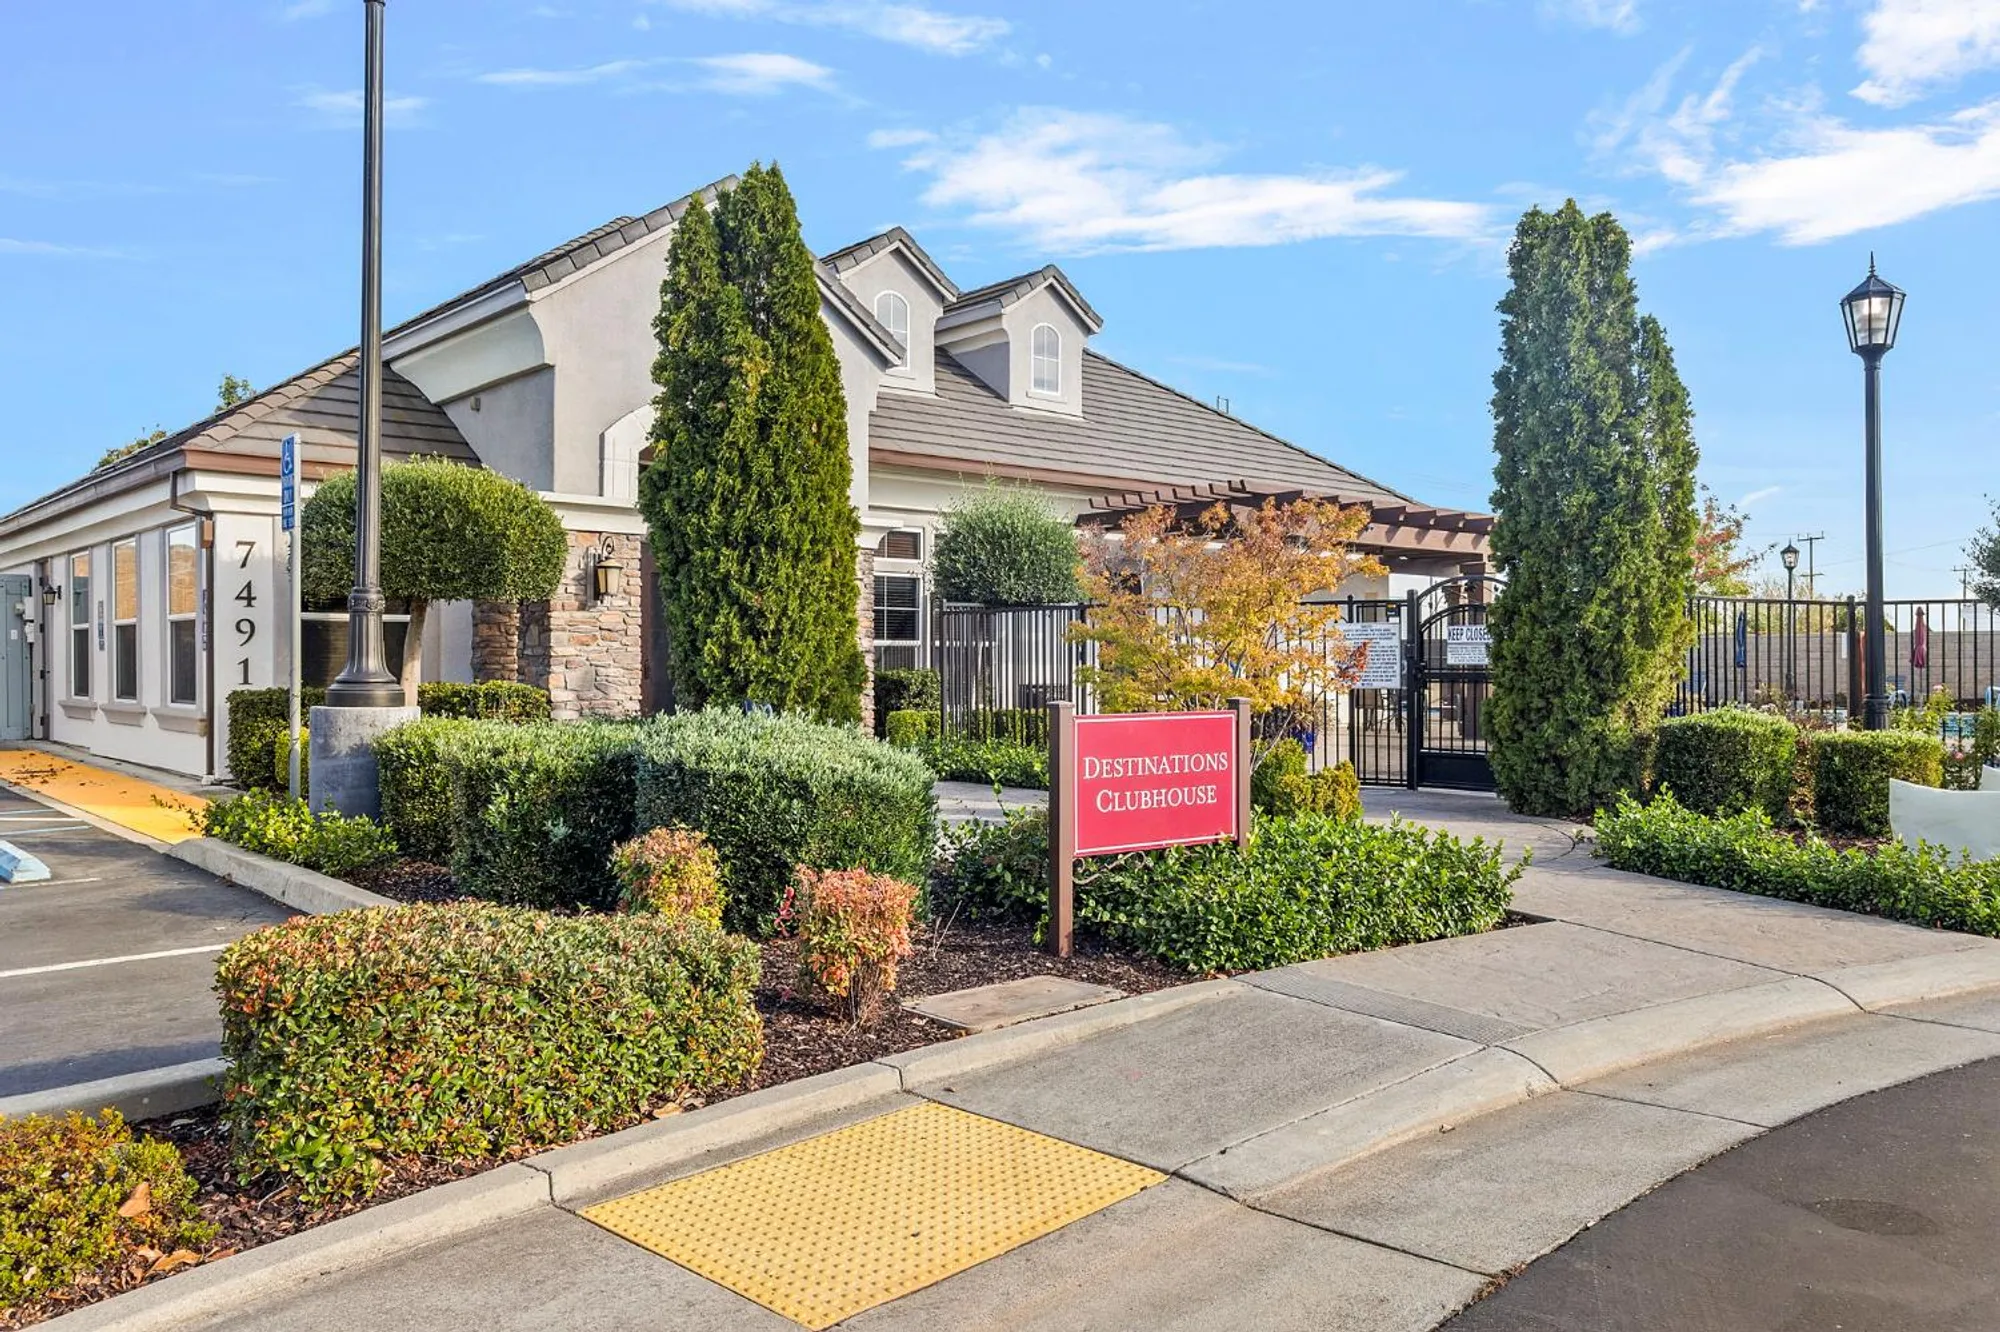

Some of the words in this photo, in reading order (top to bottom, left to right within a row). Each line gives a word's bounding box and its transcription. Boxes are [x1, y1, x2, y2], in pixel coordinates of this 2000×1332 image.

[234, 540, 257, 685] 7491
[1448, 627, 1464, 641] KEEP
[1082, 752, 1228, 779] DESTINATIONS
[1095, 785, 1217, 813] CLUBHOUSE
